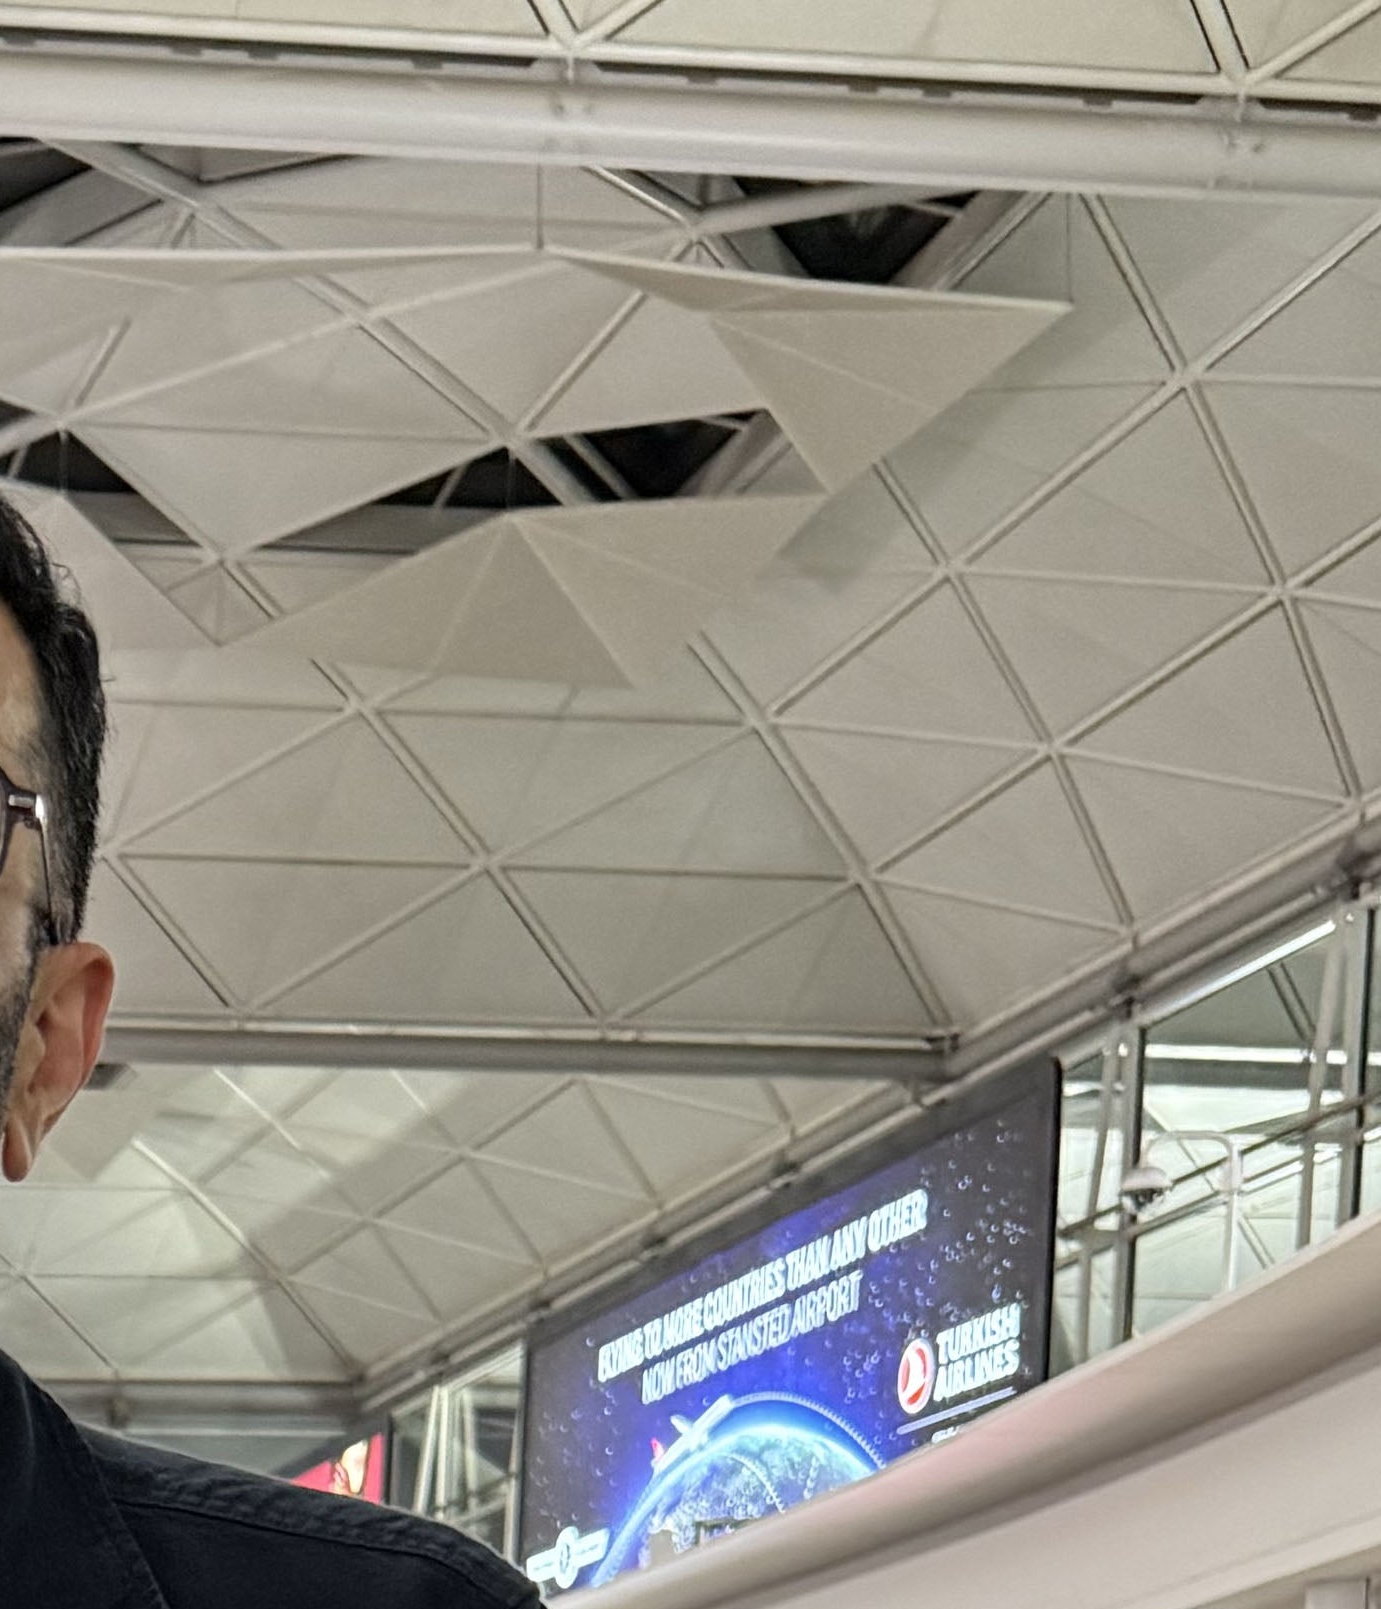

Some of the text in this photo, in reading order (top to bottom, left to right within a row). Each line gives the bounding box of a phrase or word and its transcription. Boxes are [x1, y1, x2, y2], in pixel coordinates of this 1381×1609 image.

[644, 1318, 663, 1359] TO
[663, 1297, 704, 1350] MORE
[703, 1257, 786, 1331] COUNTRIES
[786, 1235, 831, 1290] THAN
[830, 1216, 868, 1271] ANY
[867, 1189, 928, 1251] OTHER
[642, 1270, 863, 1405] NOW FROM STANSTED AIRPORT
[933, 1339, 1020, 1402] AIRLINES
[937, 1302, 1021, 1364] TURKISH
